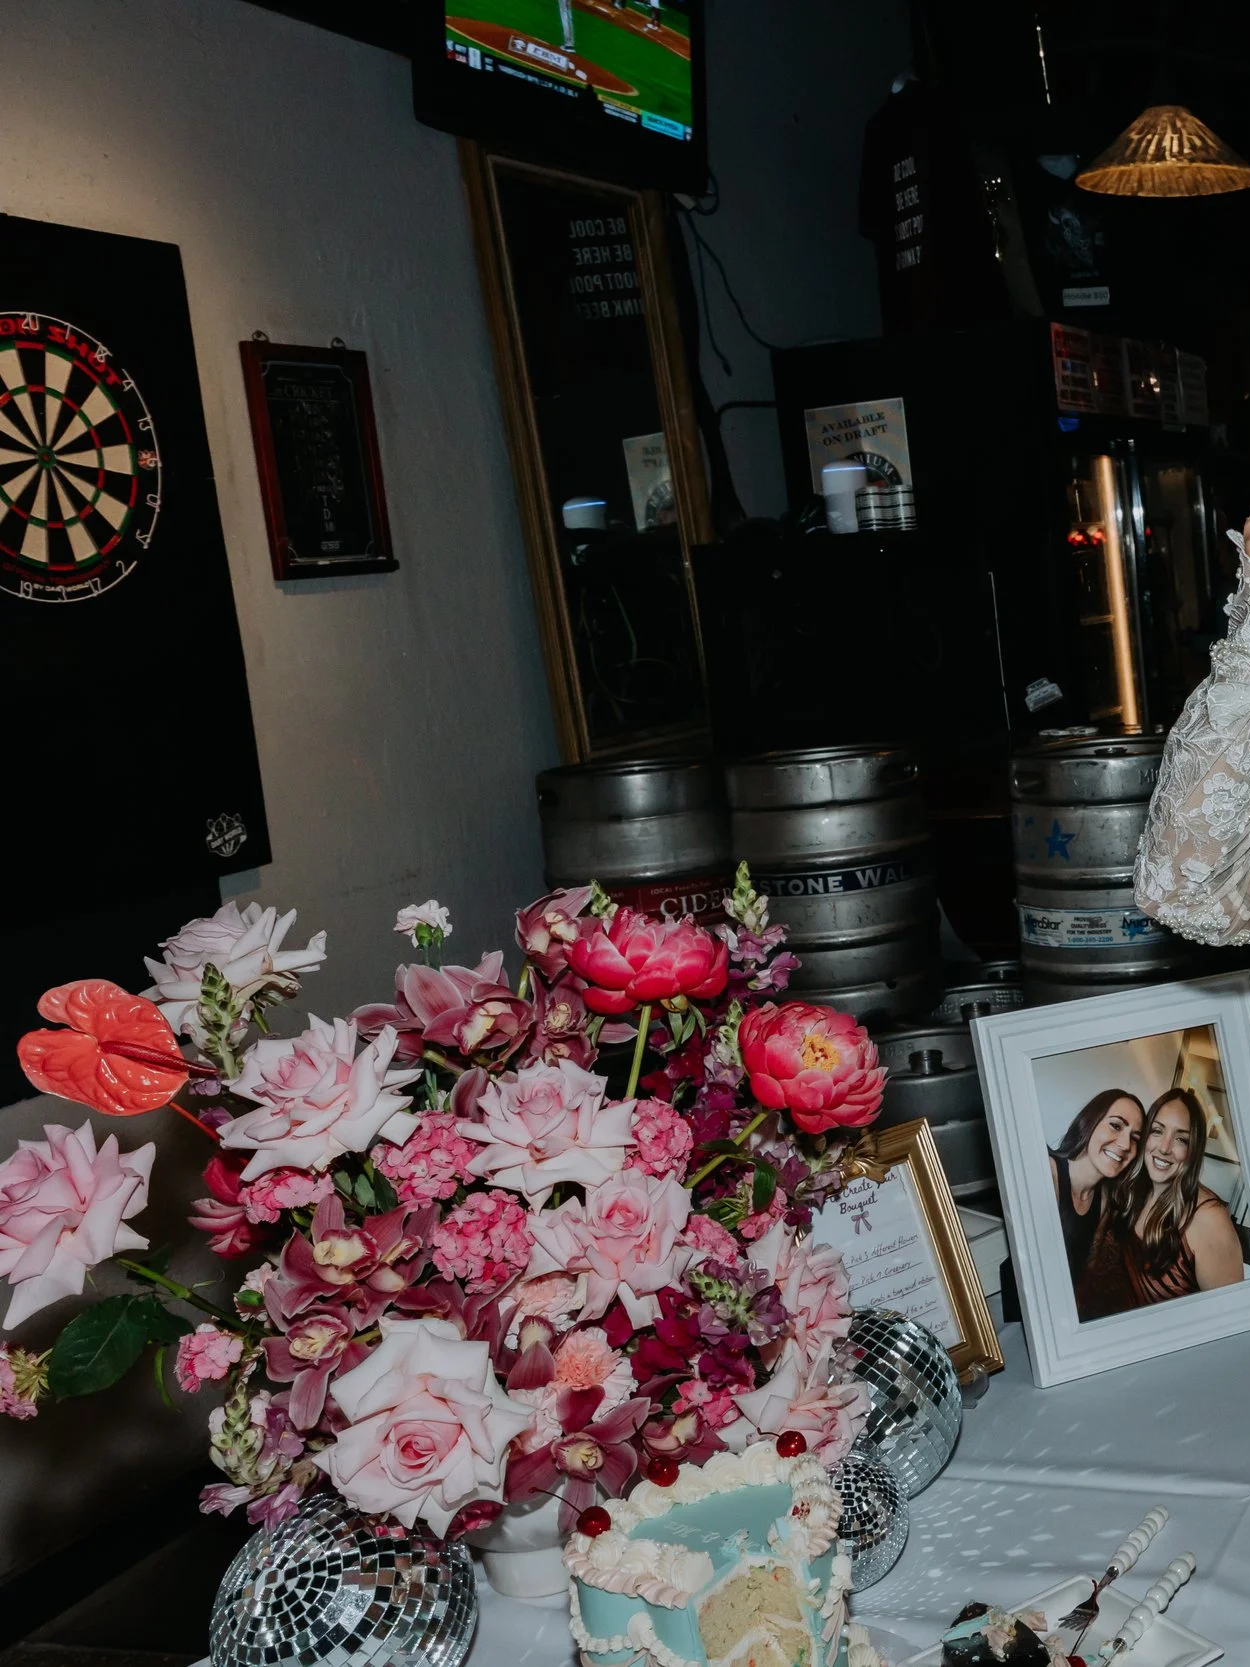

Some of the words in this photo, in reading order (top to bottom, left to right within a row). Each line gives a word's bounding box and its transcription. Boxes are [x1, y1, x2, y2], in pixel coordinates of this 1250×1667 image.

[284, 383, 333, 399] CRICKET
[821, 411, 886, 434] AVAILABLE
[823, 433, 843, 447] ON
[844, 424, 888, 442] DRAFT
[853, 453, 895, 476] MIUM
[20, 580, 33, 598] 19
[756, 874, 844, 897] STONE
[855, 864, 906, 888] WAL
[843, 1179, 873, 1198] Create
[839, 1191, 879, 1215] Bouquet
[871, 1242, 896, 1256] different
[884, 1261, 911, 1277] Greenery
